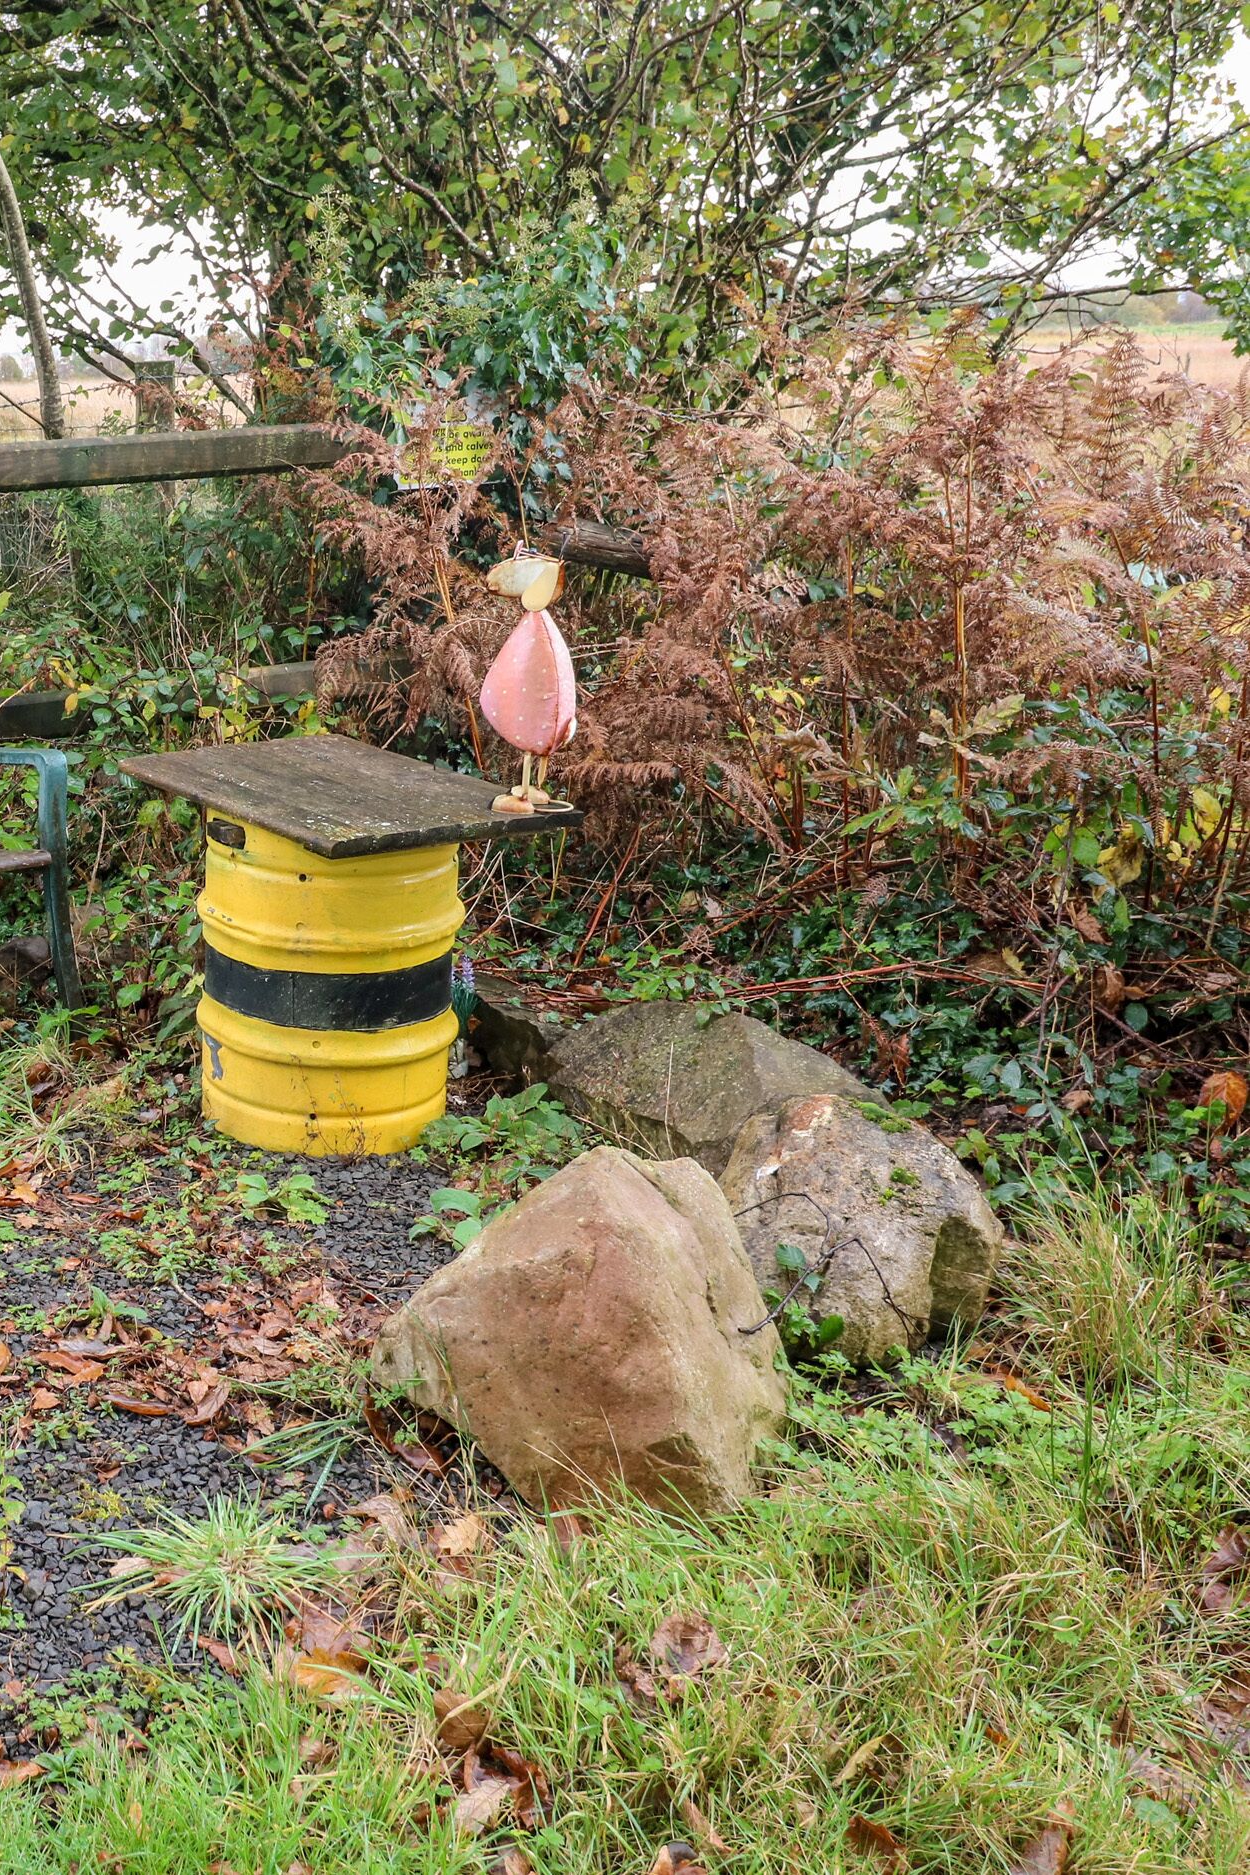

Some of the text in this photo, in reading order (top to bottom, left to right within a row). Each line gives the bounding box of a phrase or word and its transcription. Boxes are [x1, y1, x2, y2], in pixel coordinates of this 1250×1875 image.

[445, 441, 463, 451] and
[466, 440, 494, 451] calves
[446, 455, 468, 466] keep
